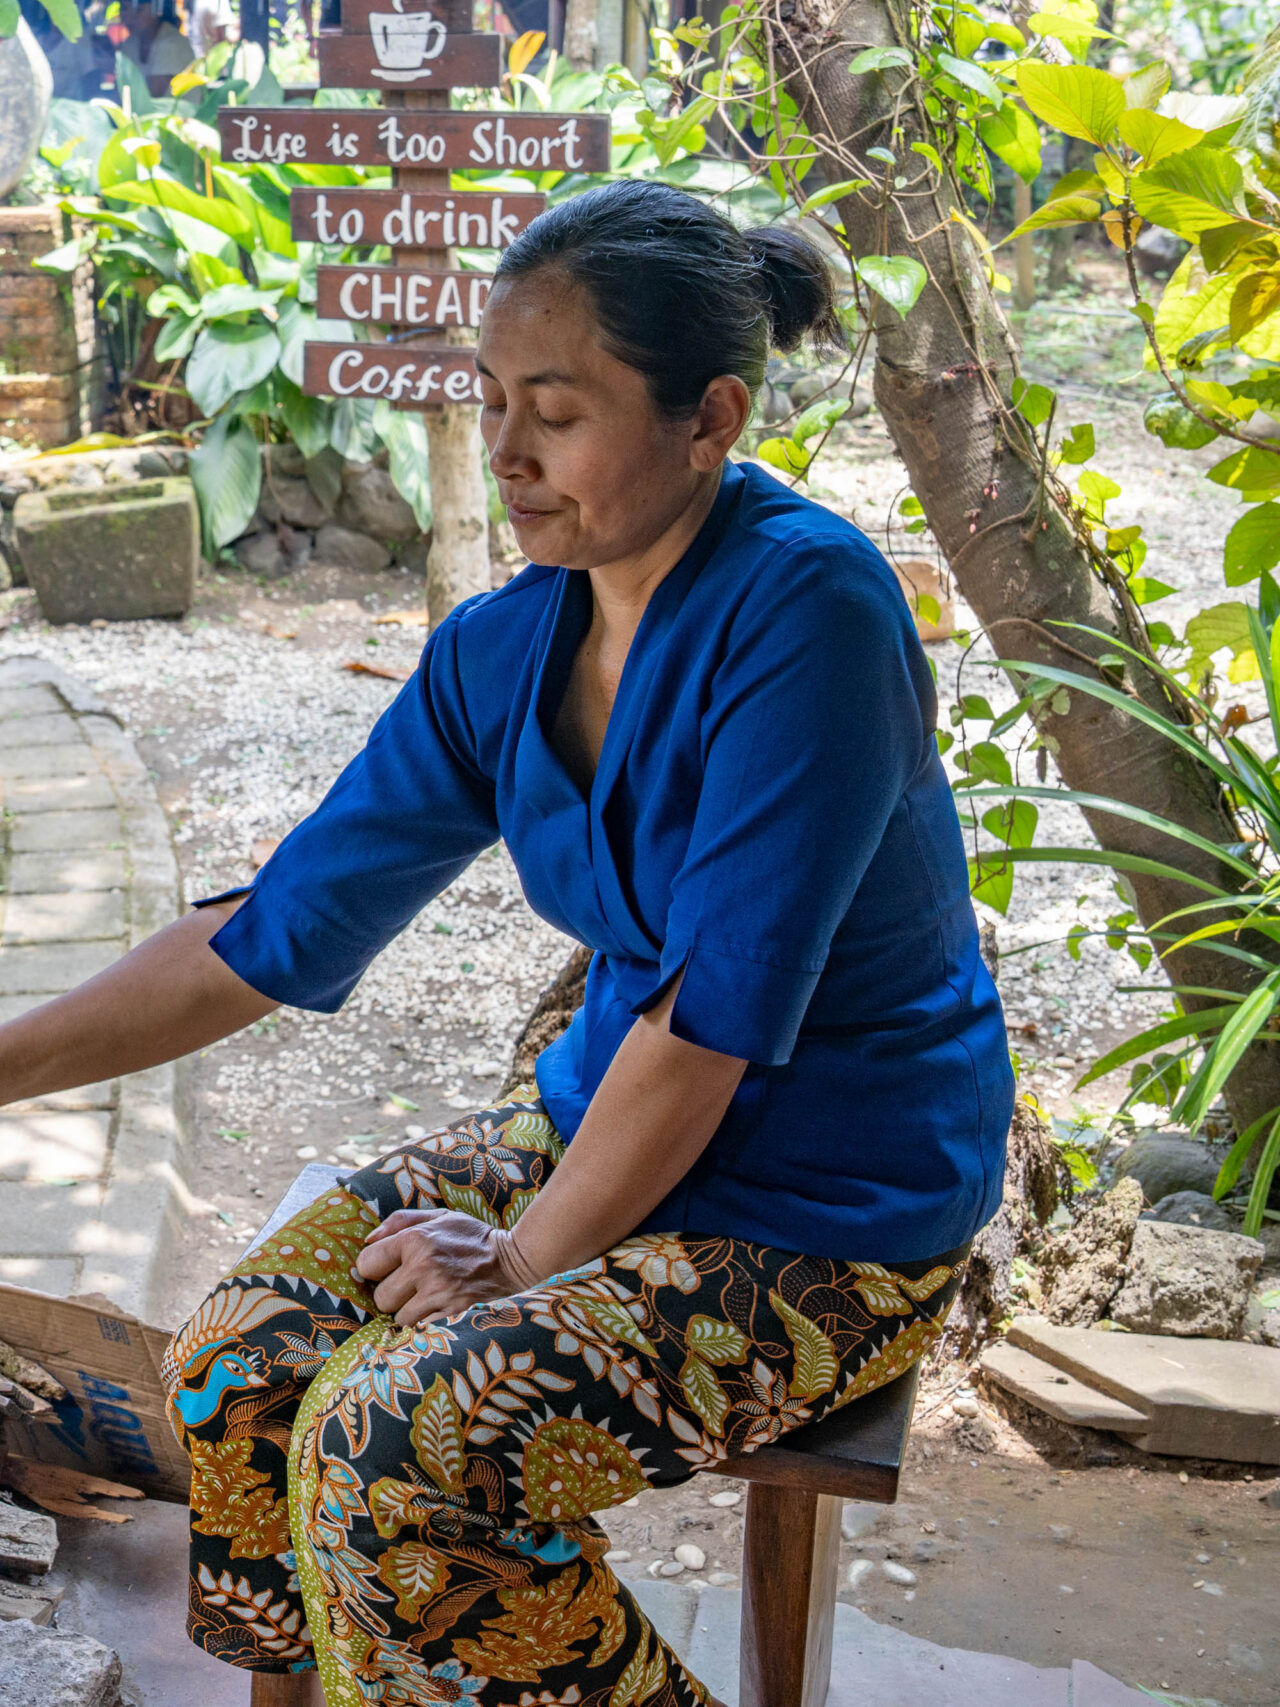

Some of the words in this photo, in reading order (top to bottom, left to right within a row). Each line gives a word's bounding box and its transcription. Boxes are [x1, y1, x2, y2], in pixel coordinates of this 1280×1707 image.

[231, 115, 307, 164] Life
[325, 122, 359, 158] is
[378, 116, 446, 163] too
[468, 117, 584, 169] Short
[311, 194, 364, 245] to
[382, 193, 519, 248] drink
[339, 272, 493, 327] CHEAP
[76, 1369, 160, 1475] AQUA
